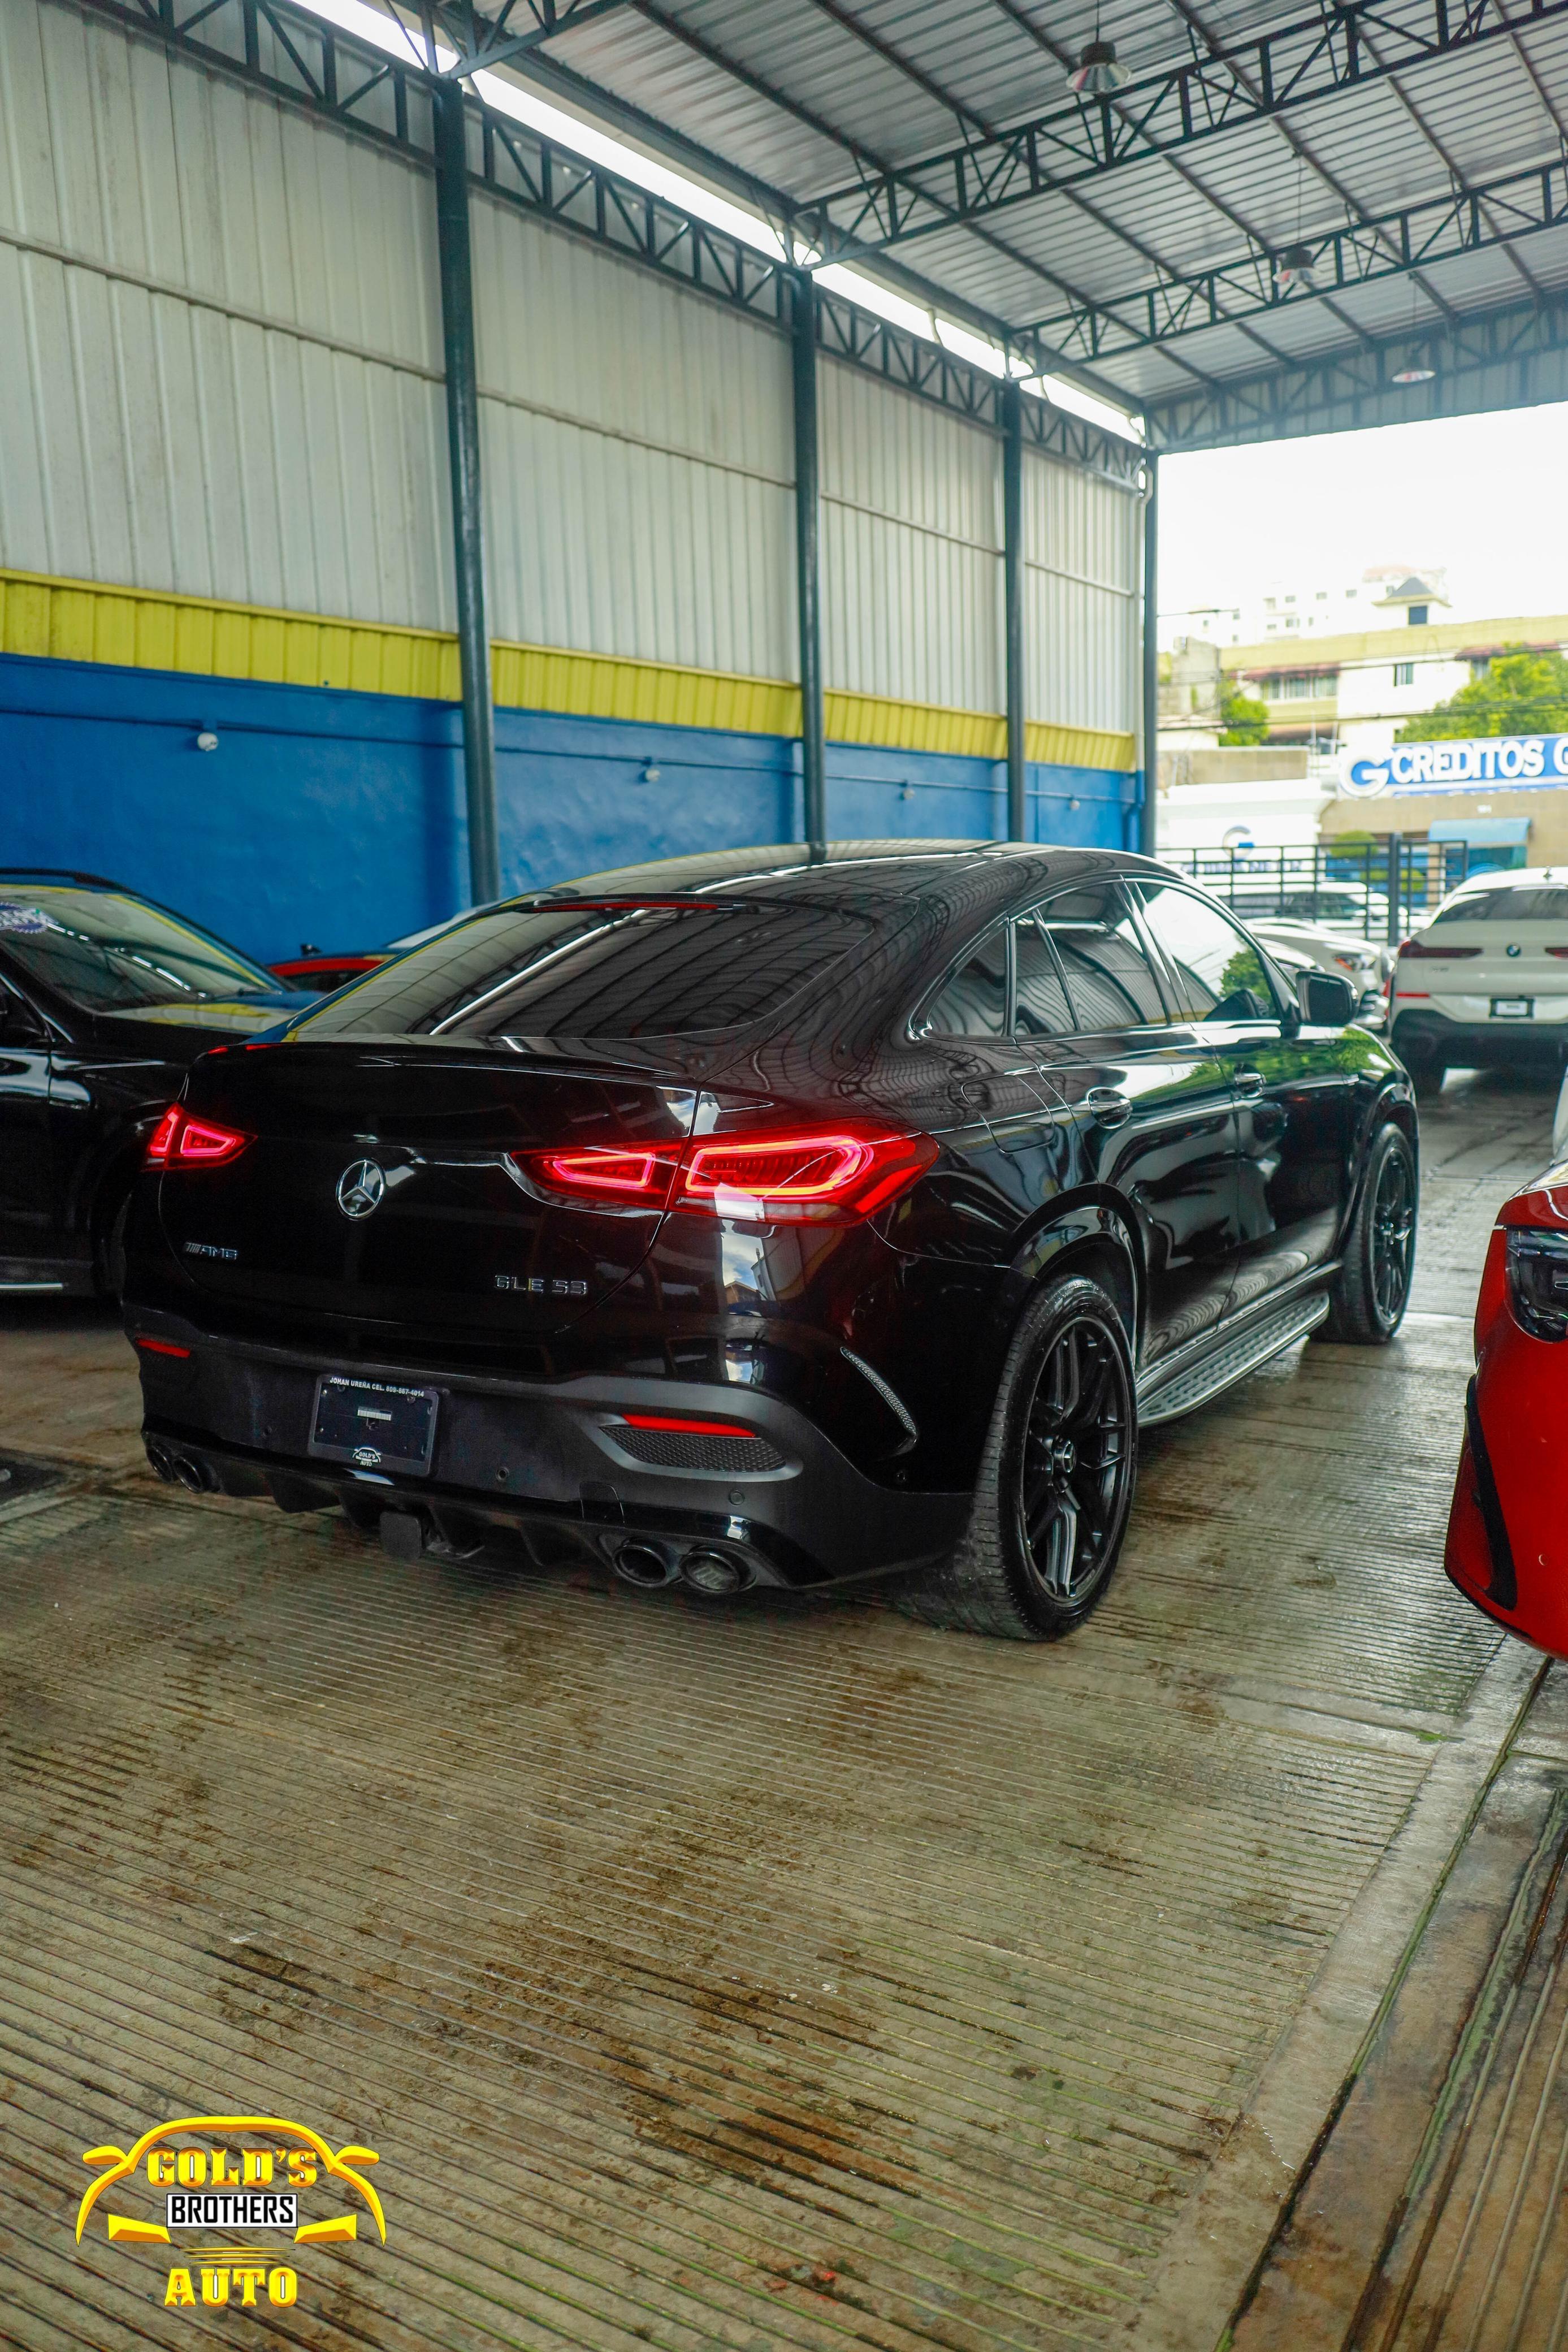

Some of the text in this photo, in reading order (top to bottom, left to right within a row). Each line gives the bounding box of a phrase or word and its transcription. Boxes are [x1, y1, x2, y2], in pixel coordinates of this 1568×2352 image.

[1391, 739, 1545, 784] CREDITOS
[494, 1275, 588, 1295] GLE 53
[330, 1377, 349, 1386] JOHAN
[350, 1380, 371, 1389] UREÑA
